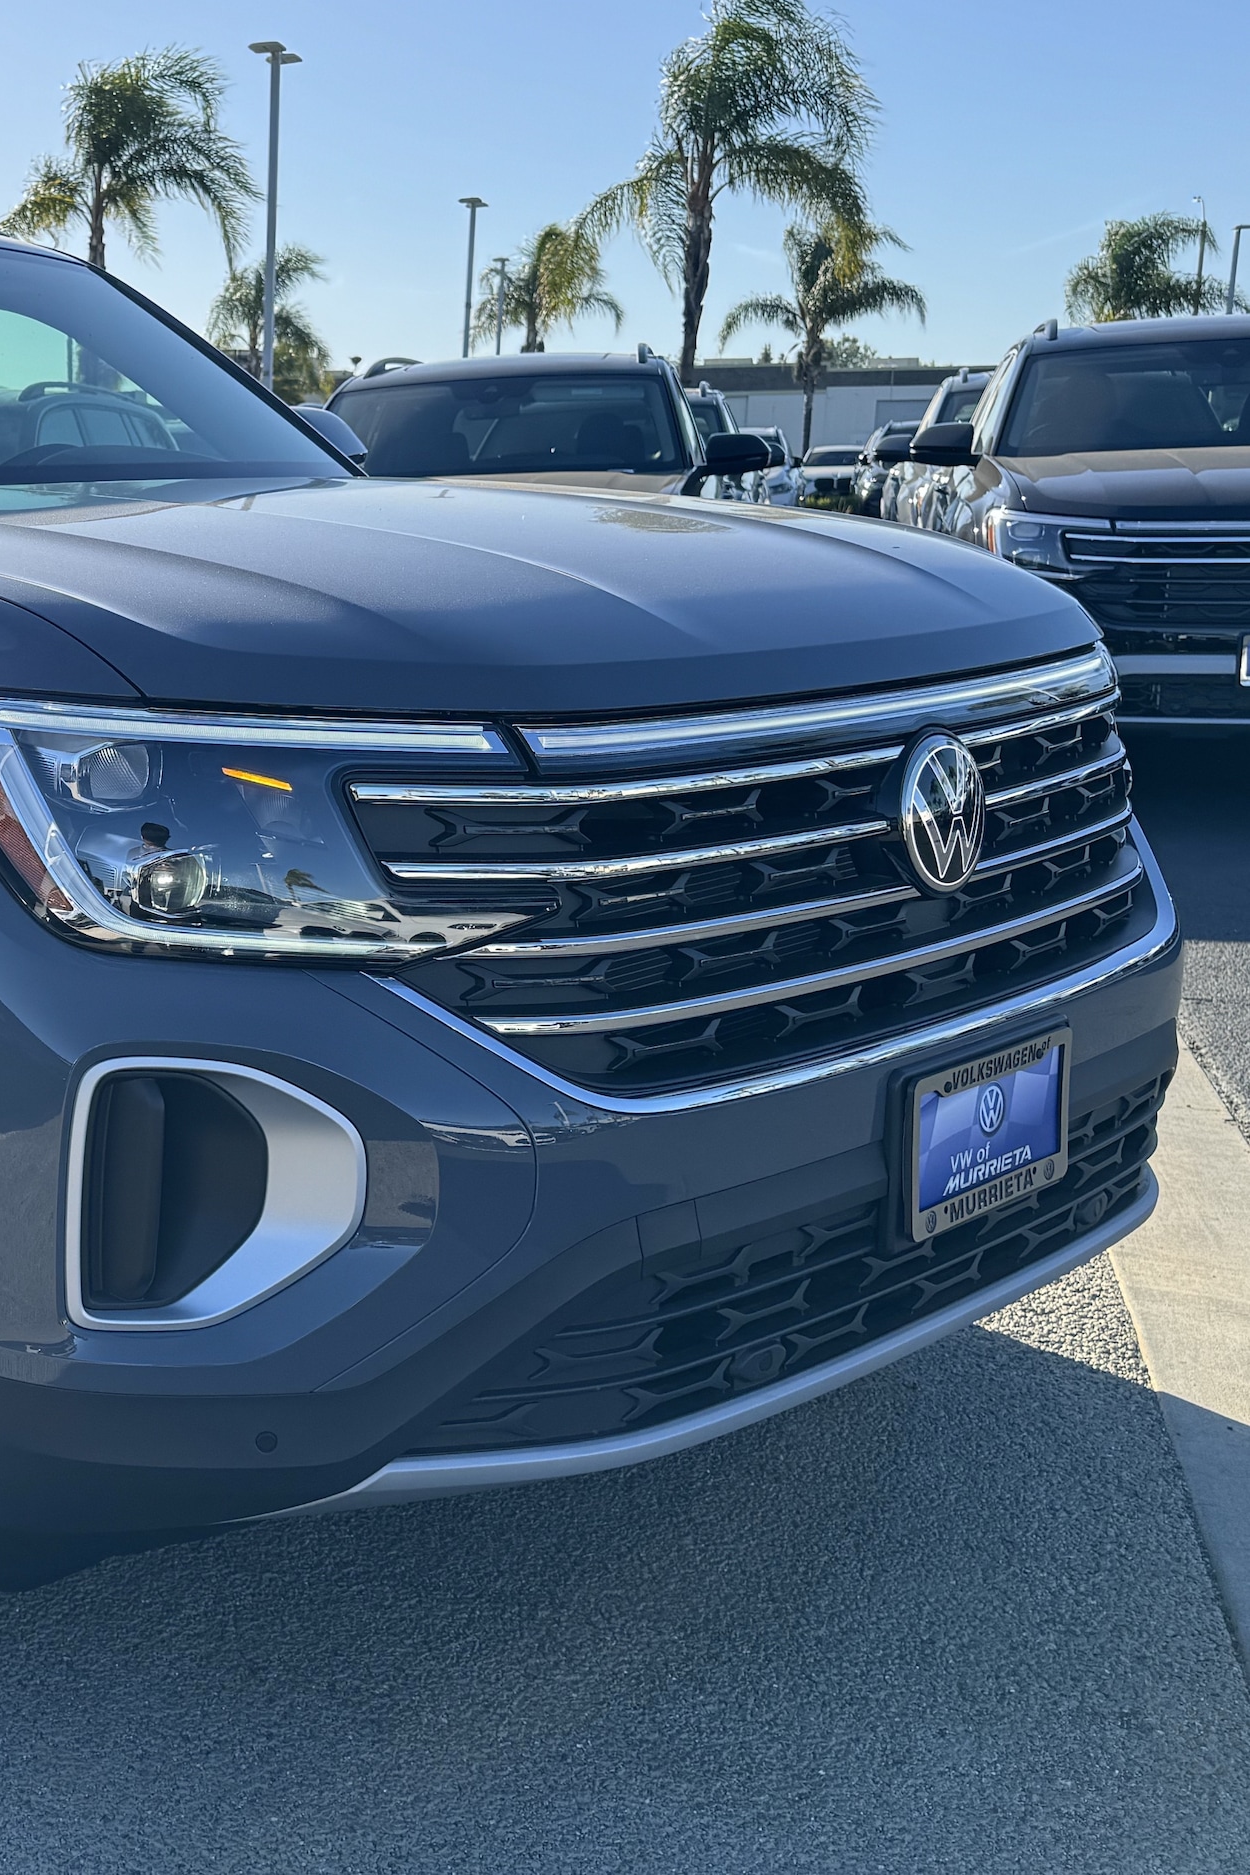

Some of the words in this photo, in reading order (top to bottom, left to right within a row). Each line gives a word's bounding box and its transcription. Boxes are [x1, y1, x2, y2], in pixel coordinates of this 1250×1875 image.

[952, 1043, 1037, 1090] VOLKSWAGEN
[1041, 1036, 1052, 1052] of
[942, 1144, 1032, 1196] MURRIETA
[950, 1148, 973, 1173] VW
[976, 1141, 990, 1162] of
[949, 1167, 1034, 1223] MURRIETA
